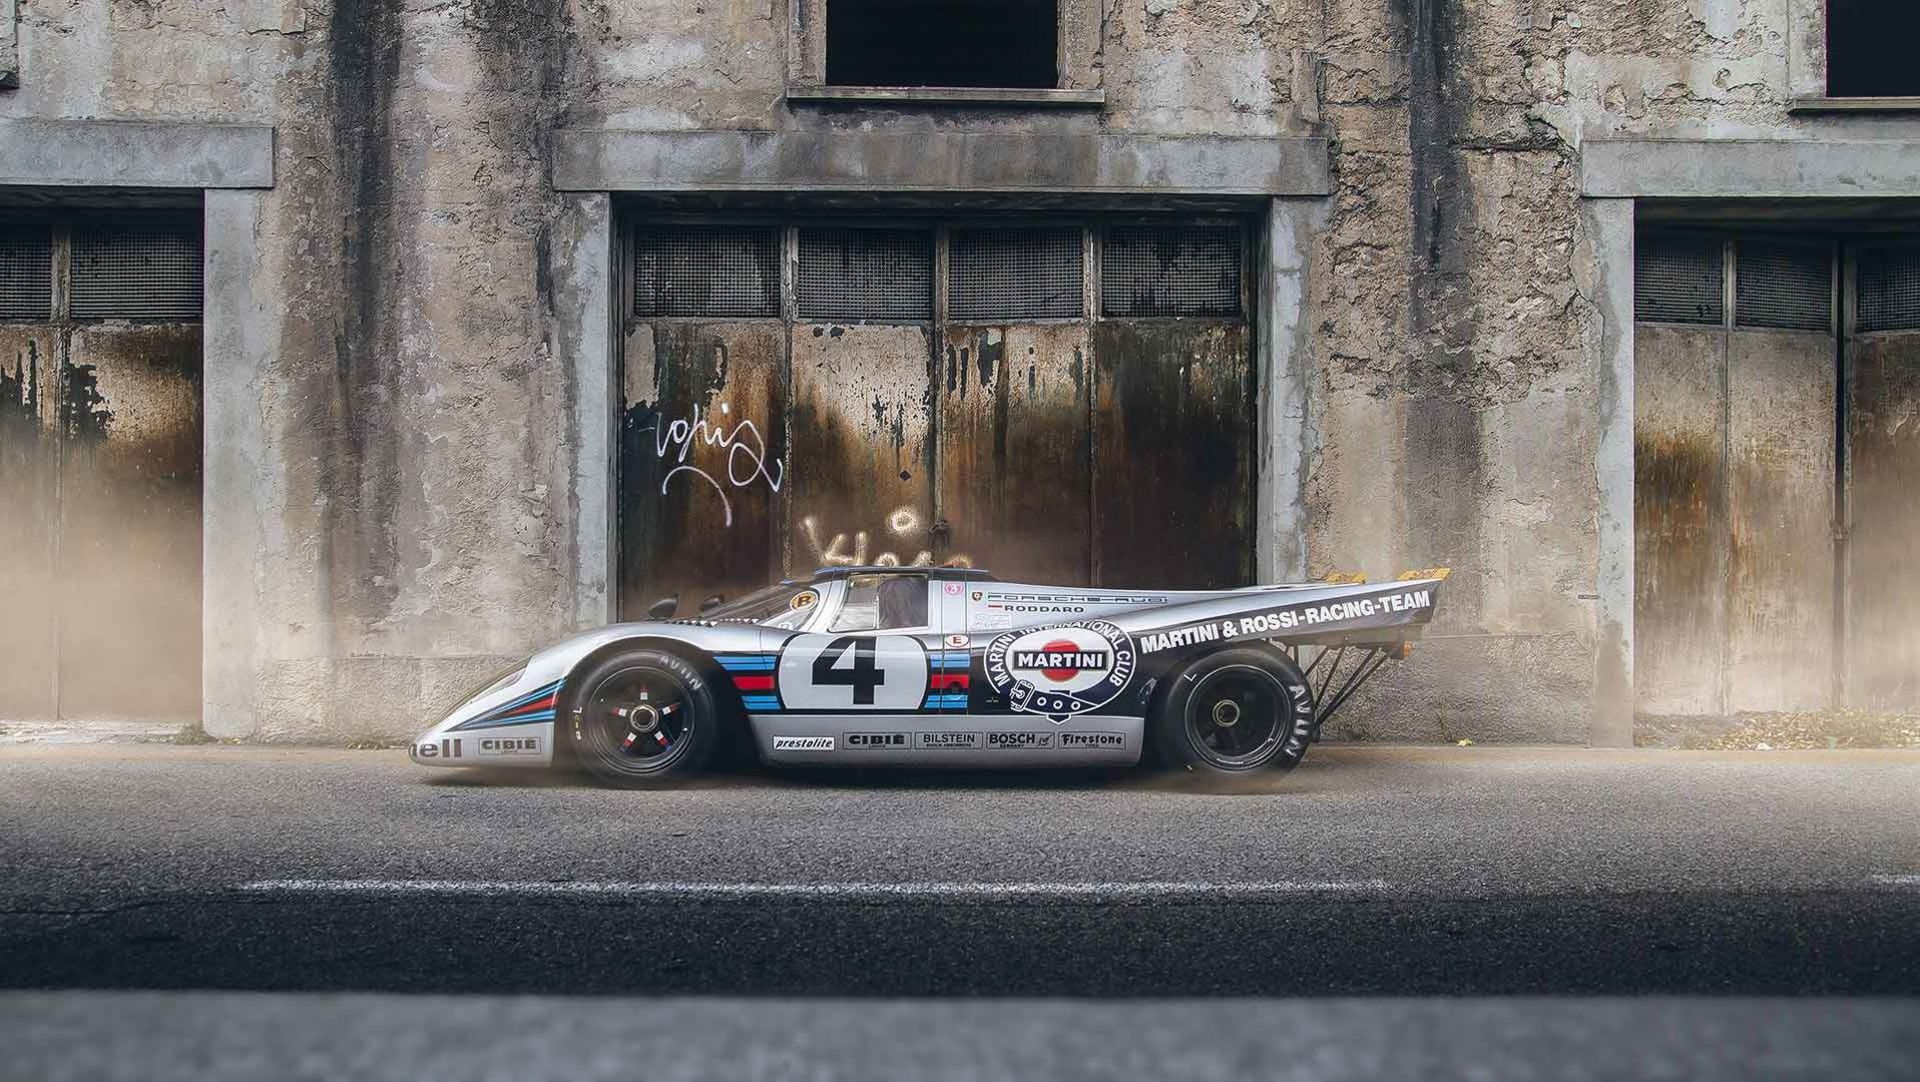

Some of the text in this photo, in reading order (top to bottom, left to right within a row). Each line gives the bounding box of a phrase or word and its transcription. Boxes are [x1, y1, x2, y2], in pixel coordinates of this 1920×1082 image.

[1004, 604, 1085, 614] RODDARO
[1140, 590, 1431, 655] MARTINI & ROSSI-RACING-TEAM
[988, 620, 1132, 688] MARTINI INTERNATIONAL CLUB
[1017, 652, 1104, 668] MARTINI
[811, 635, 885, 705] 4
[775, 736, 833, 749] prestolite
[923, 733, 975, 743] BILSTEIN
[989, 733, 1035, 744] BOSCH
[1060, 733, 1122, 746] Firestone
